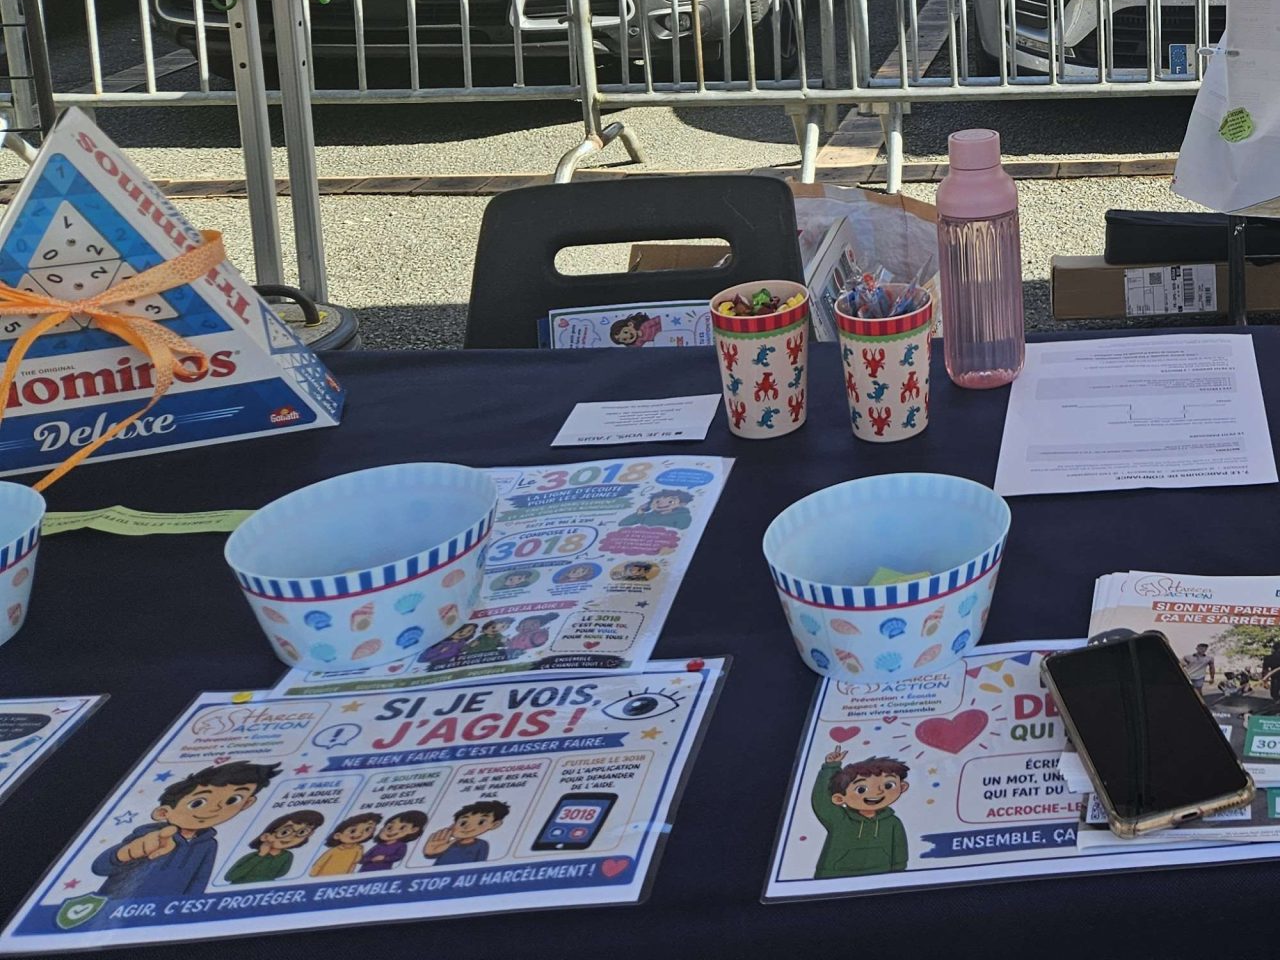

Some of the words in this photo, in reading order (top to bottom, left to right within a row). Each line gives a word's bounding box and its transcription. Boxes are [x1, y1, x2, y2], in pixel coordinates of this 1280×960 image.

[21, 368, 36, 376] THE
[38, 365, 76, 374] ORIGINAL
[270, 410, 300, 424] Goliath
[33, 412, 177, 452] Deluxe
[518, 478, 536, 488] Le
[537, 462, 653, 492] 3018
[489, 534, 587, 561] 3018
[1156, 602, 1169, 611] SI
[1176, 604, 1193, 612] ON
[1199, 604, 1230, 613] N'EN
[1234, 606, 1279, 615] PARLE
[1161, 614, 1180, 623] ÇA
[1206, 615, 1274, 625] S'ARRÊTE
[375, 697, 426, 722] SI
[433, 691, 493, 717] JE
[507, 684, 602, 709] VOIS,
[372, 711, 557, 750] J'AGIS
[1010, 724, 1055, 740] QUI
[341, 757, 366, 768] NE
[368, 754, 401, 767] RIEN
[406, 749, 450, 763] FAIRE,
[456, 746, 496, 759] C'EST
[500, 741, 561, 754] LAISSER
[564, 737, 605, 750] FAIRE.
[561, 757, 607, 768] J'UTILISE
[624, 754, 645, 762] 3018
[578, 764, 641, 774] L'APPLICATION
[586, 772, 635, 782] DEMANDER
[982, 776, 1001, 786] UN
[1006, 774, 1037, 785] MOT,
[586, 781, 615, 789] L'AIDE.
[984, 790, 1007, 800] QUI
[1012, 788, 1040, 798] FAIT
[1046, 786, 1064, 795] DU
[559, 809, 596, 820] 3018
[952, 831, 1046, 850] ENSEMBLE,
[1053, 828, 1076, 841] ÇA
[110, 905, 156, 920] AGIR,
[164, 900, 212, 915] C'EST
[217, 890, 306, 910] PROTÉGER.
[313, 880, 401, 901] ENSEMBLE,
[408, 878, 450, 892] STOP
[452, 875, 477, 888] AU
[479, 865, 586, 885] HARCÈLEMENT
